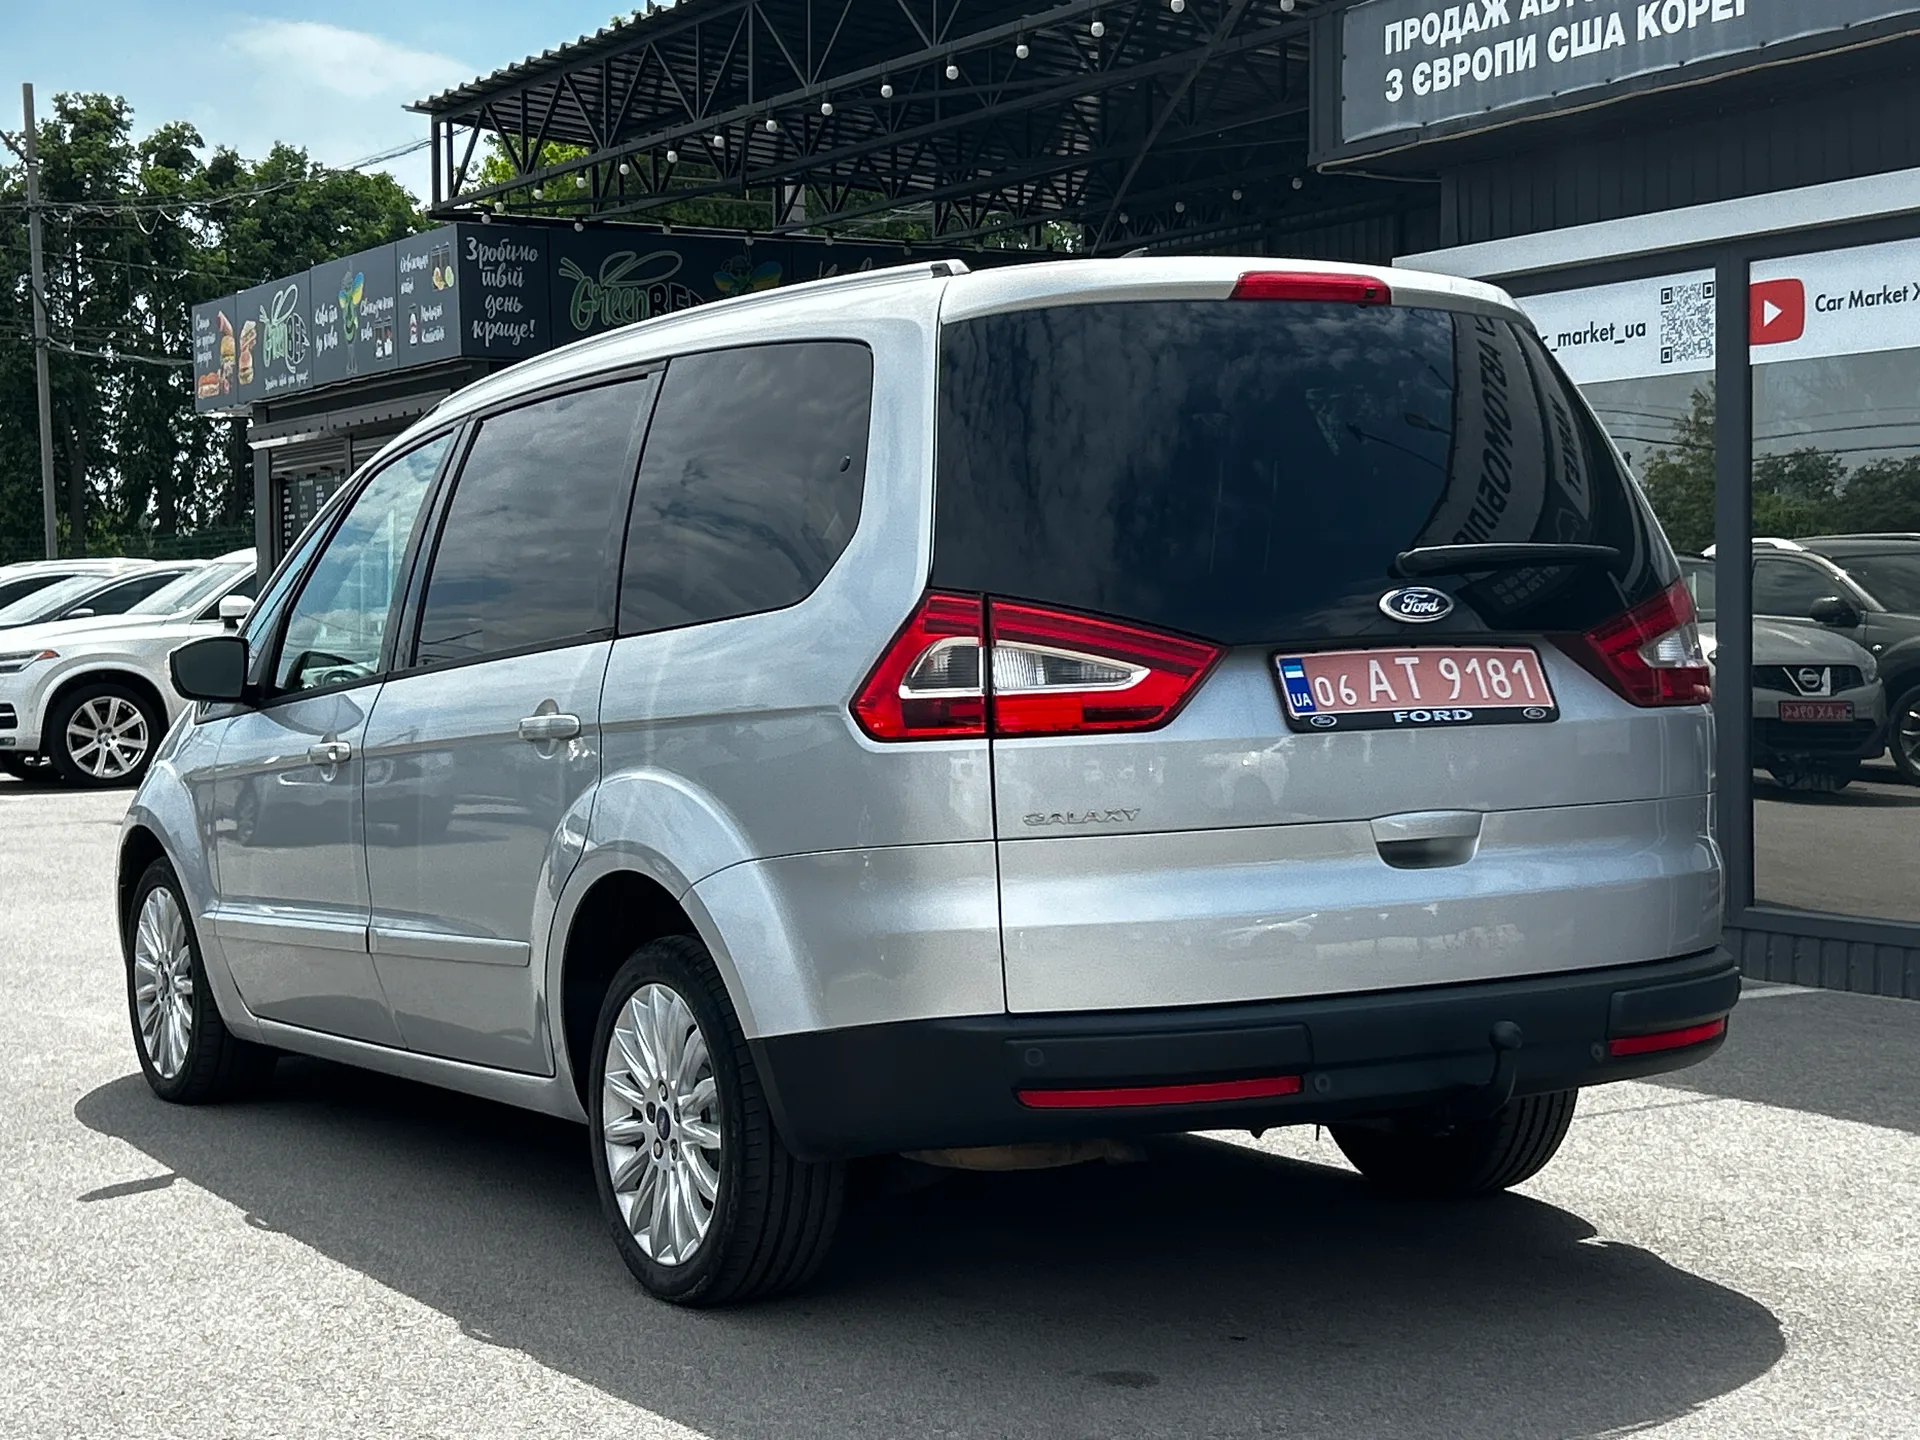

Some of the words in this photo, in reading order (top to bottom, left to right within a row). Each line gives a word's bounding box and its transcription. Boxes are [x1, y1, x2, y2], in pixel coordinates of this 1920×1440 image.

[1384, 0, 1510, 55] ПРОДАЖ
[1385, 68, 1403, 103] З
[1412, 34, 1537, 96] ЄВРОПИ
[1547, 12, 1626, 63] США
[466, 236, 539, 270] Зробимо
[482, 262, 525, 288] твій
[485, 294, 524, 320] день
[1815, 293, 1845, 313] Car
[1848, 284, 1909, 310] Market
[471, 319, 536, 348] краще!
[1400, 593, 1440, 614] Ford
[1313, 674, 1358, 708] 06
[1369, 656, 1422, 703] AT
[1437, 657, 1536, 701] 9181
[1291, 693, 1313, 708] UA
[1393, 708, 1474, 723] FORD
[1022, 807, 1141, 827] GALAXY
